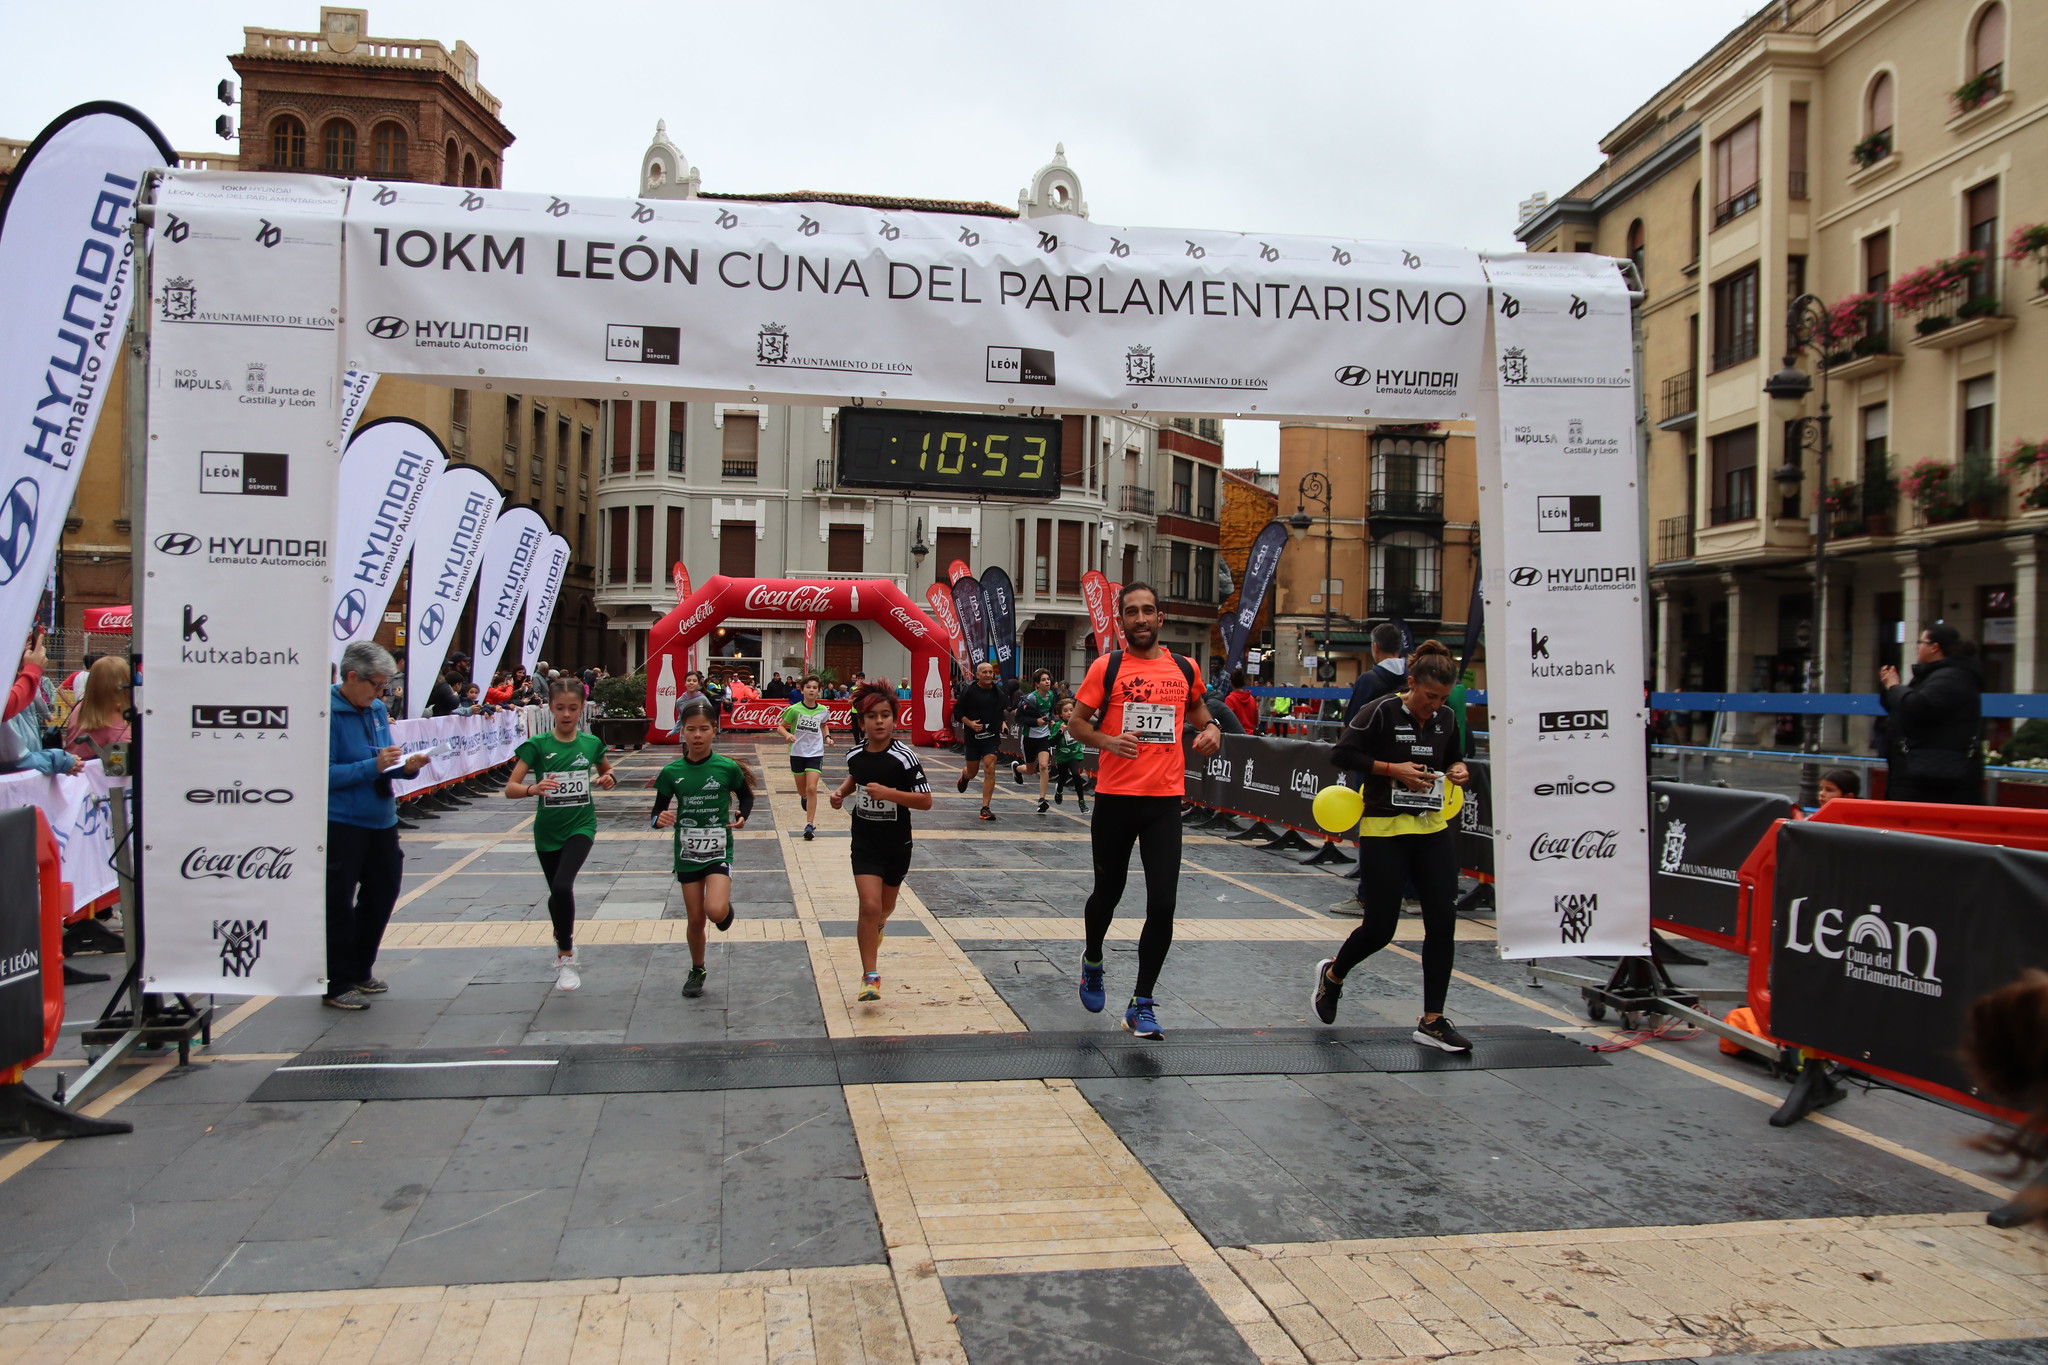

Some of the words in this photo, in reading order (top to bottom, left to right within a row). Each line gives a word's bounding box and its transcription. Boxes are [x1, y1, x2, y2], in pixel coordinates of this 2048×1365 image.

[246, 194, 338, 205] PARLAMENTARISMO
[373, 227, 526, 275] 10KM
[556, 234, 699, 286] LEÓN
[718, 251, 870, 298] CUNA
[888, 262, 982, 303] DEL
[1000, 270, 1467, 327] PARLAMENTARISMO
[24, 172, 137, 464] HYUNDAI
[200, 313, 285, 324] AYUNTAMIENTO
[289, 316, 302, 325] DE
[307, 317, 335, 327] LEÓN
[415, 320, 529, 343] HYUNDAI
[415, 339, 461, 349] Lemauto
[463, 340, 528, 353] Automoción
[610, 336, 640, 350] LEÓN
[790, 357, 867, 370] AYUNTAMIENTO
[871, 362, 884, 370] DE
[887, 361, 913, 372] LEÓN
[991, 357, 1019, 371] LEÓN
[175, 369, 198, 377] NOS
[1376, 369, 1459, 388] HYUNDAI
[1530, 376, 1595, 385] AYUNTAMIENTO
[1608, 376, 1631, 385] LEÓN
[175, 379, 232, 391] IMPULSA
[1157, 376, 1228, 387] AYUNTAMIENTO
[1231, 378, 1243, 386] DE
[1245, 377, 1268, 388] LEÓN
[268, 386, 299, 396] Junta
[302, 387, 316, 397] de
[1376, 386, 1411, 395] Lemauto
[1413, 386, 1457, 396] Automoción
[239, 395, 277, 405] Castilla
[279, 398, 286, 408] y
[289, 398, 316, 407] León
[53, 356, 102, 471] Lemauto
[1515, 434, 1558, 445] IMPULSA
[1585, 438, 1606, 446] Junta
[1593, 448, 1598, 456] y
[206, 465, 240, 478] LEÓN
[354, 450, 423, 584] HYUNDAI
[1542, 507, 1568, 518] LEÓN
[376, 534, 404, 587] Lemauto
[399, 458, 434, 533] Automoción
[209, 537, 327, 558] HYUNDAI
[435, 491, 486, 599] HYUNDAI
[452, 558, 473, 602] Lemauto
[469, 498, 494, 557] Automoción
[209, 556, 258, 565] Lemauto
[261, 557, 327, 567] Automoción
[495, 526, 537, 618] HYUNDAI
[506, 582, 524, 621] Lemauto
[521, 531, 543, 583] Automoción
[1548, 567, 1636, 583] HYUNDAI
[537, 548, 564, 624] HYUNDAI
[1548, 584, 1583, 592] Lemauto
[1583, 583, 1636, 591] Automoción
[745, 584, 831, 613] Coca-Cola
[679, 598, 714, 635] Coca-Cola
[890, 606, 929, 638] Coca-Cola
[182, 645, 299, 665] kutxabank
[1531, 660, 1616, 678] kutxabank
[196, 708, 287, 725] LEON
[801, 720, 817, 728] 2256
[1136, 715, 1163, 729] 317
[1541, 713, 1607, 729] LEON
[192, 731, 289, 739] PLAZA
[1538, 733, 1610, 741] PLAZA
[186, 780, 294, 804] emico
[1534, 774, 1616, 796] emico
[862, 797, 885, 809] 316
[688, 839, 719, 850] 3773
[1681, 863, 1739, 881] AYUNTAMIENT
[1562, 926, 1590, 944] NY
[0, 959, 7, 976] E
[9, 948, 39, 973] LEÓN
[1848, 946, 1873, 965] Cuna
[1875, 952, 1892, 970] del
[222, 956, 259, 978] NY
[1846, 961, 1942, 998] Parlamentarismo
